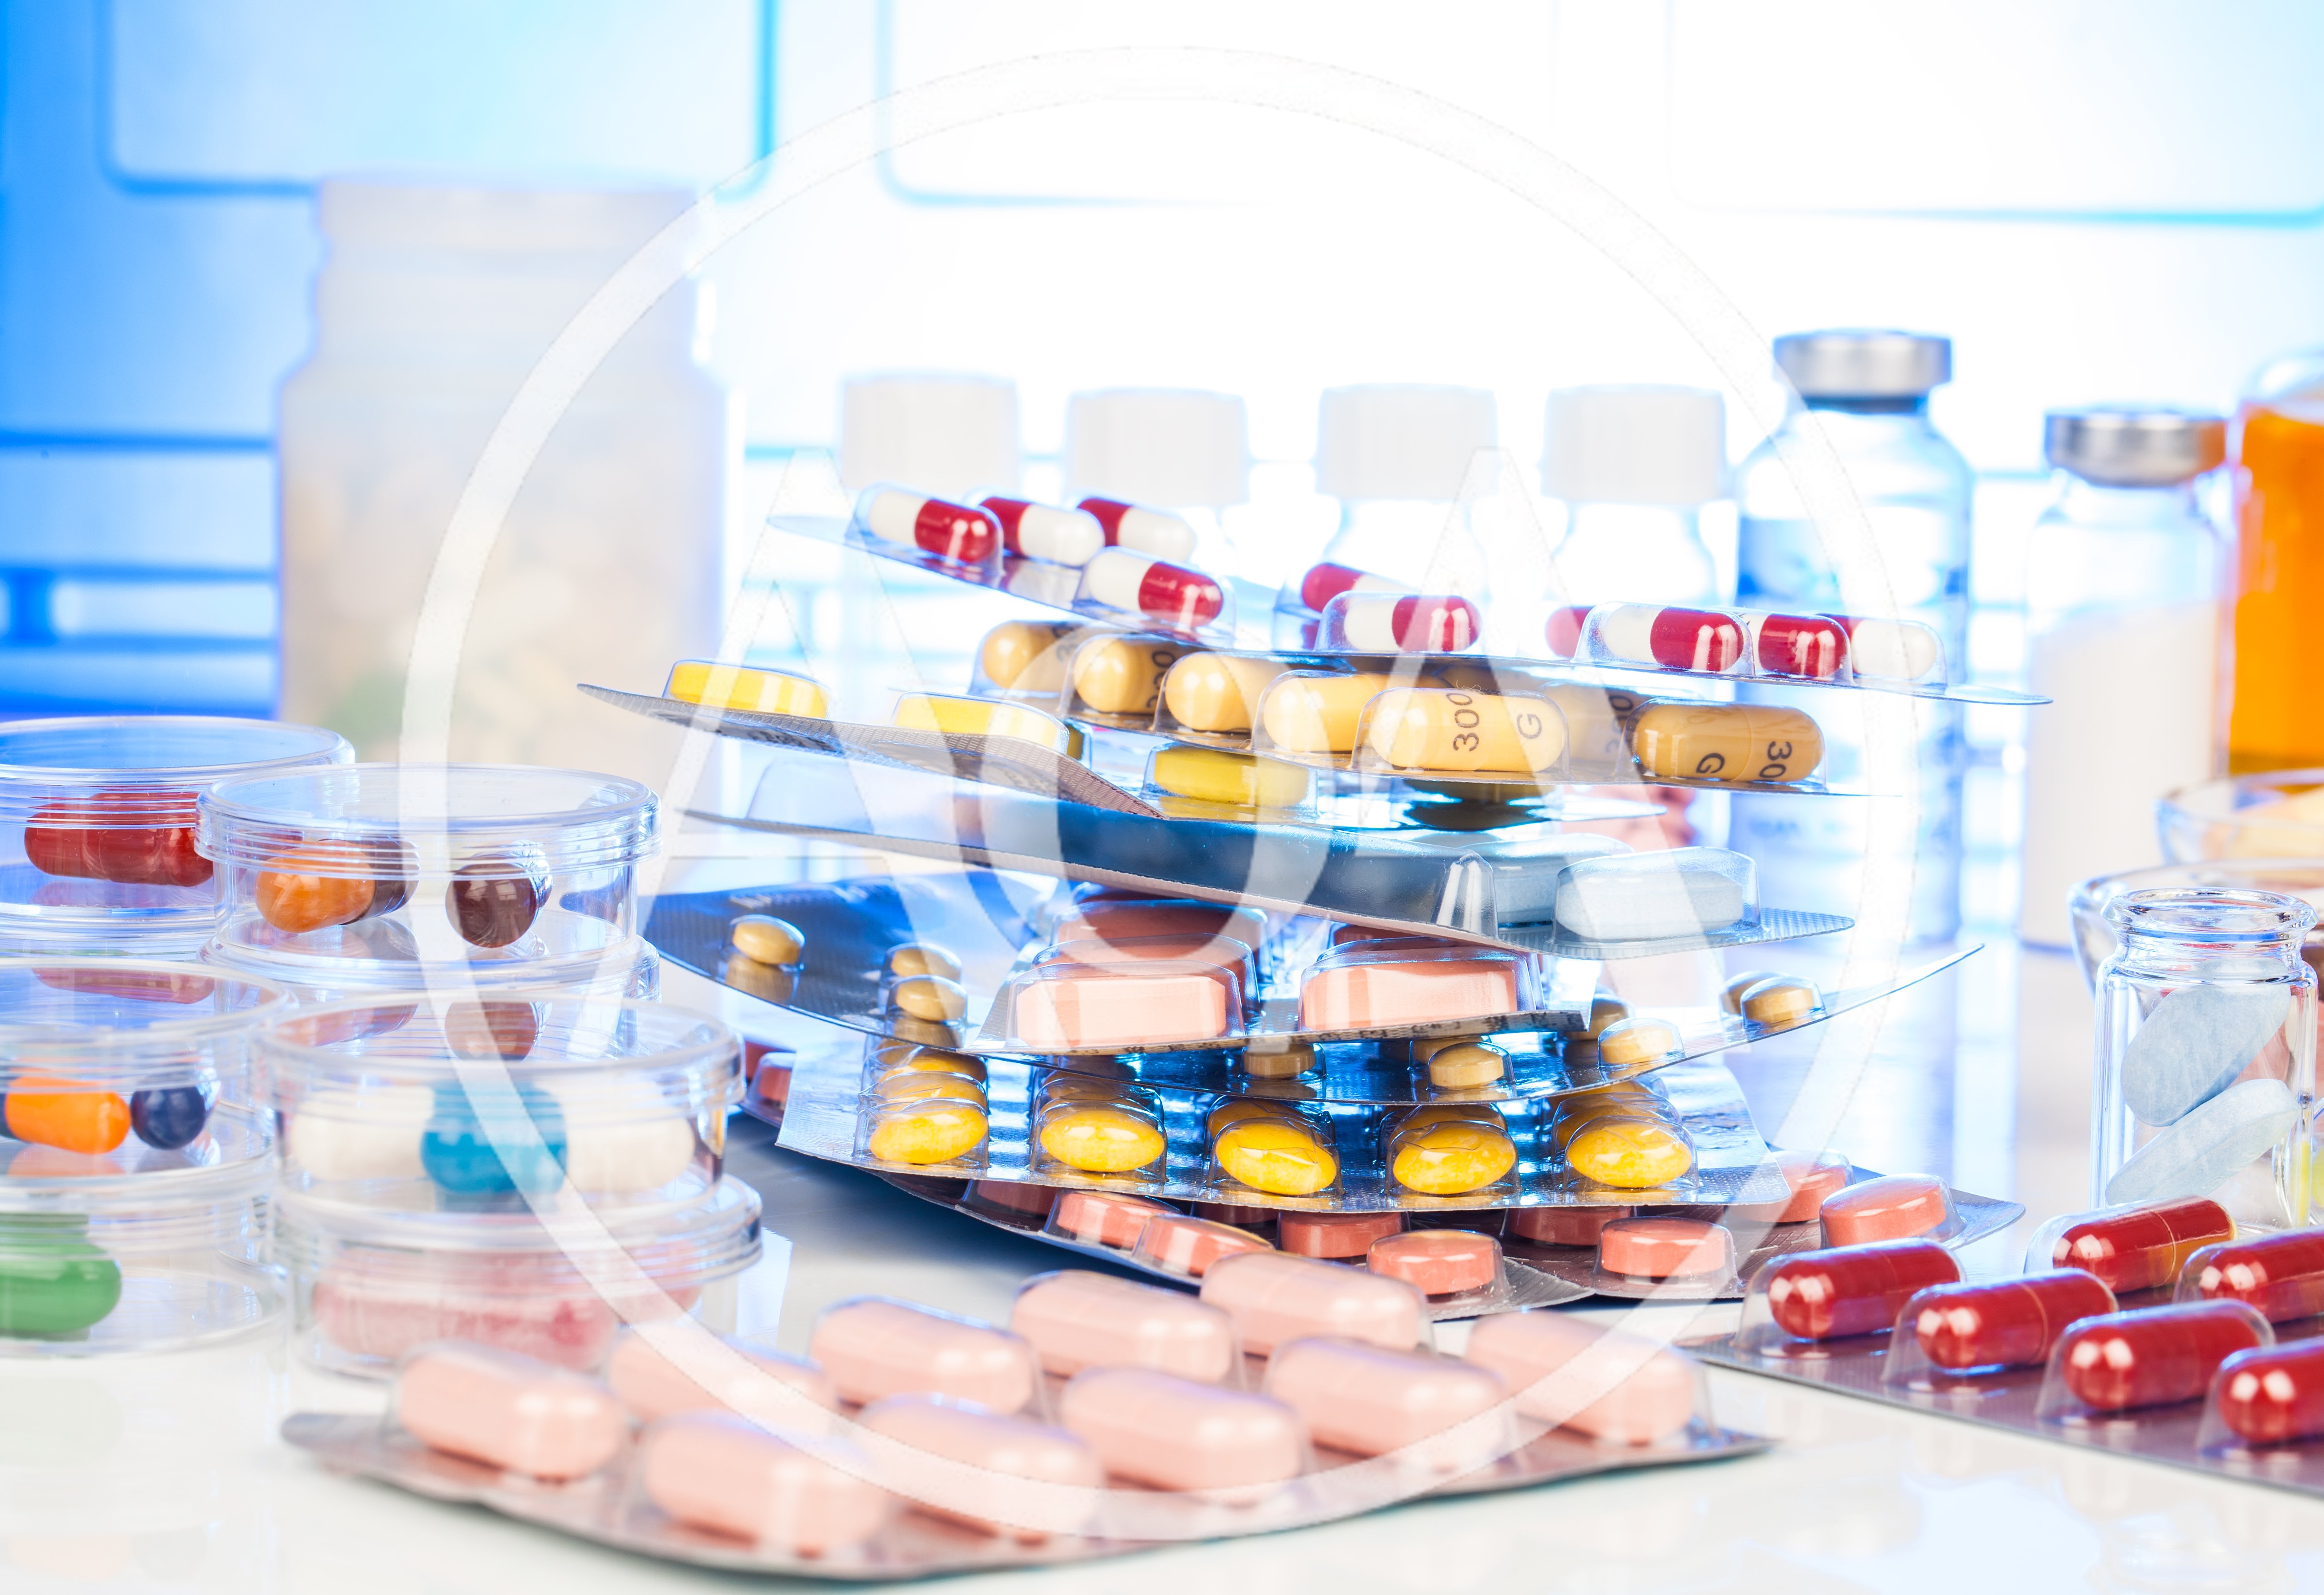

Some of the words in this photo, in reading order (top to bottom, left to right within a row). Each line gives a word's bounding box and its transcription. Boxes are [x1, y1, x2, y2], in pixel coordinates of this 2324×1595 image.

[1445, 693, 1480, 752] 300
[1517, 713, 1542, 739] G
[1696, 752, 1725, 774] G
